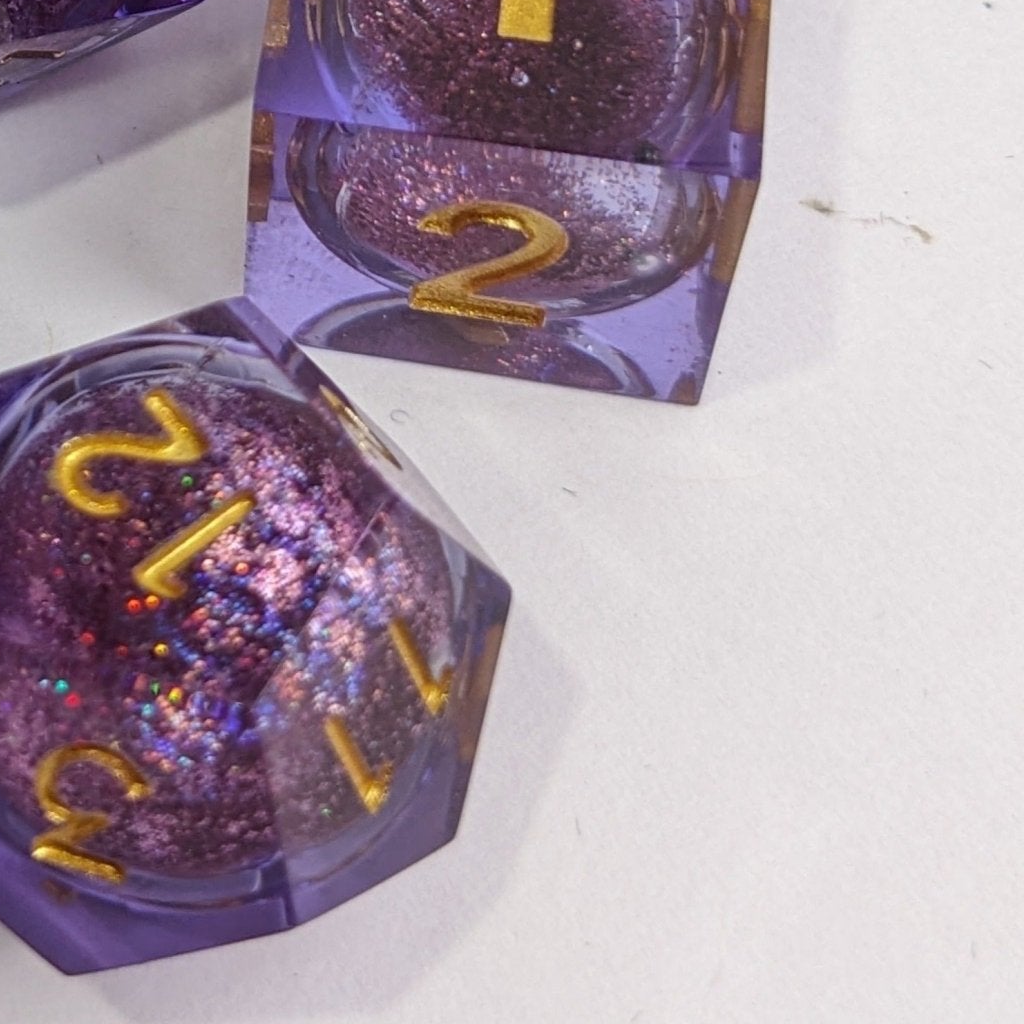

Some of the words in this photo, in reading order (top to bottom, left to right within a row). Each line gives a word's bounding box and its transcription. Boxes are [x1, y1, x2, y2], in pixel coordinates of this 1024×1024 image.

[409, 200, 568, 327] 2
[52, 387, 258, 598] 12
[31, 742, 152, 883] 3
